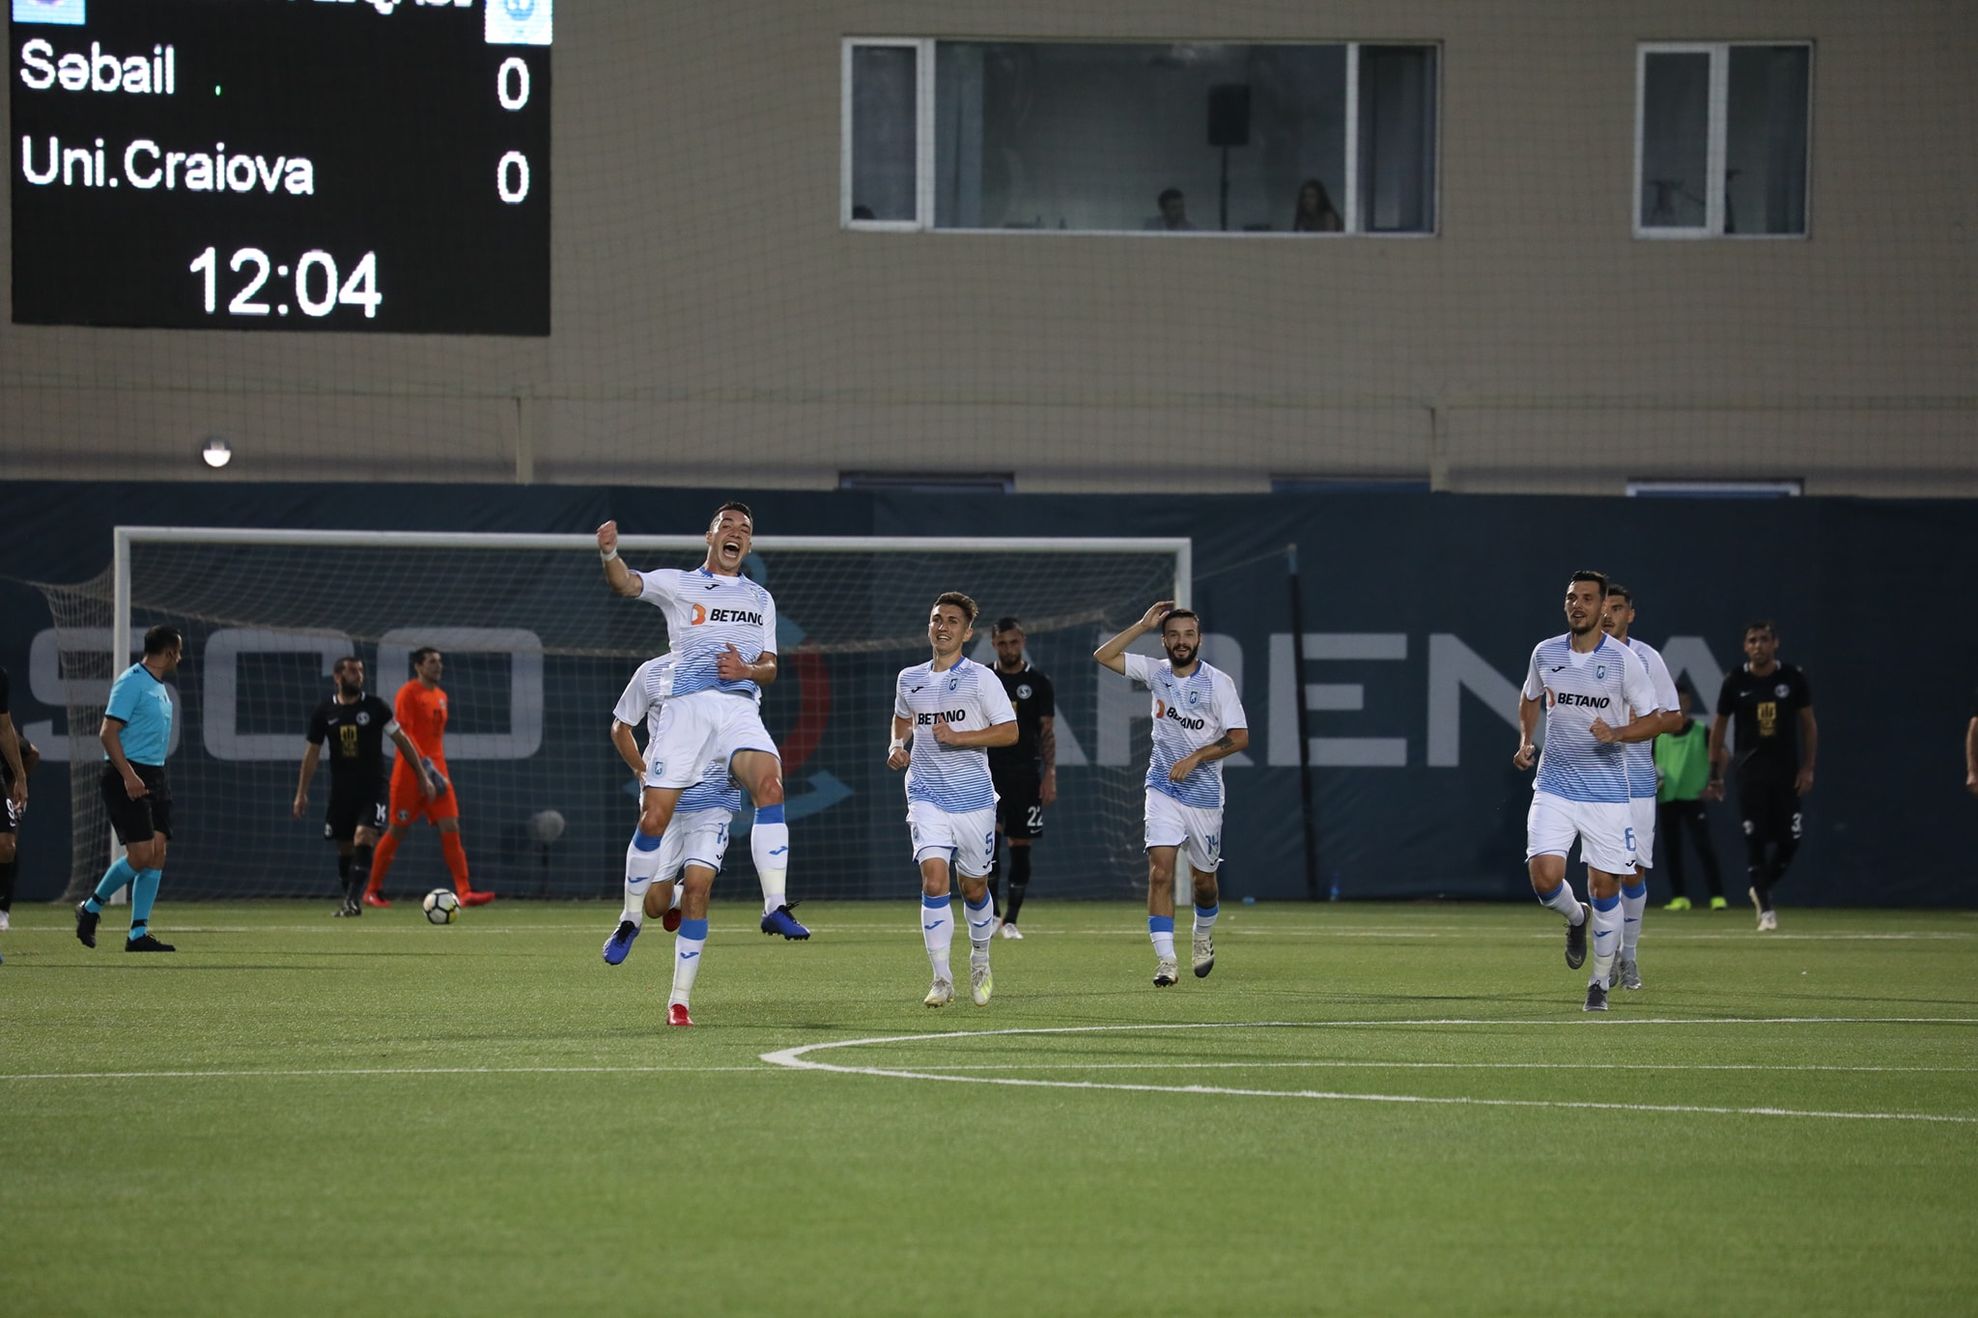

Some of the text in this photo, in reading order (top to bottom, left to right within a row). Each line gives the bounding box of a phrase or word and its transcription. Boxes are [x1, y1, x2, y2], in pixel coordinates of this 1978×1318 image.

[498, 57, 529, 110] 0
[23, 136, 529, 203] Uni.Craiova 0
[190, 247, 382, 318] 12:04
[1558, 692, 1610, 709] BETANO
[1167, 707, 1204, 730] BANO
[985, 832, 993, 856] 5
[1624, 826, 1637, 852] 6
